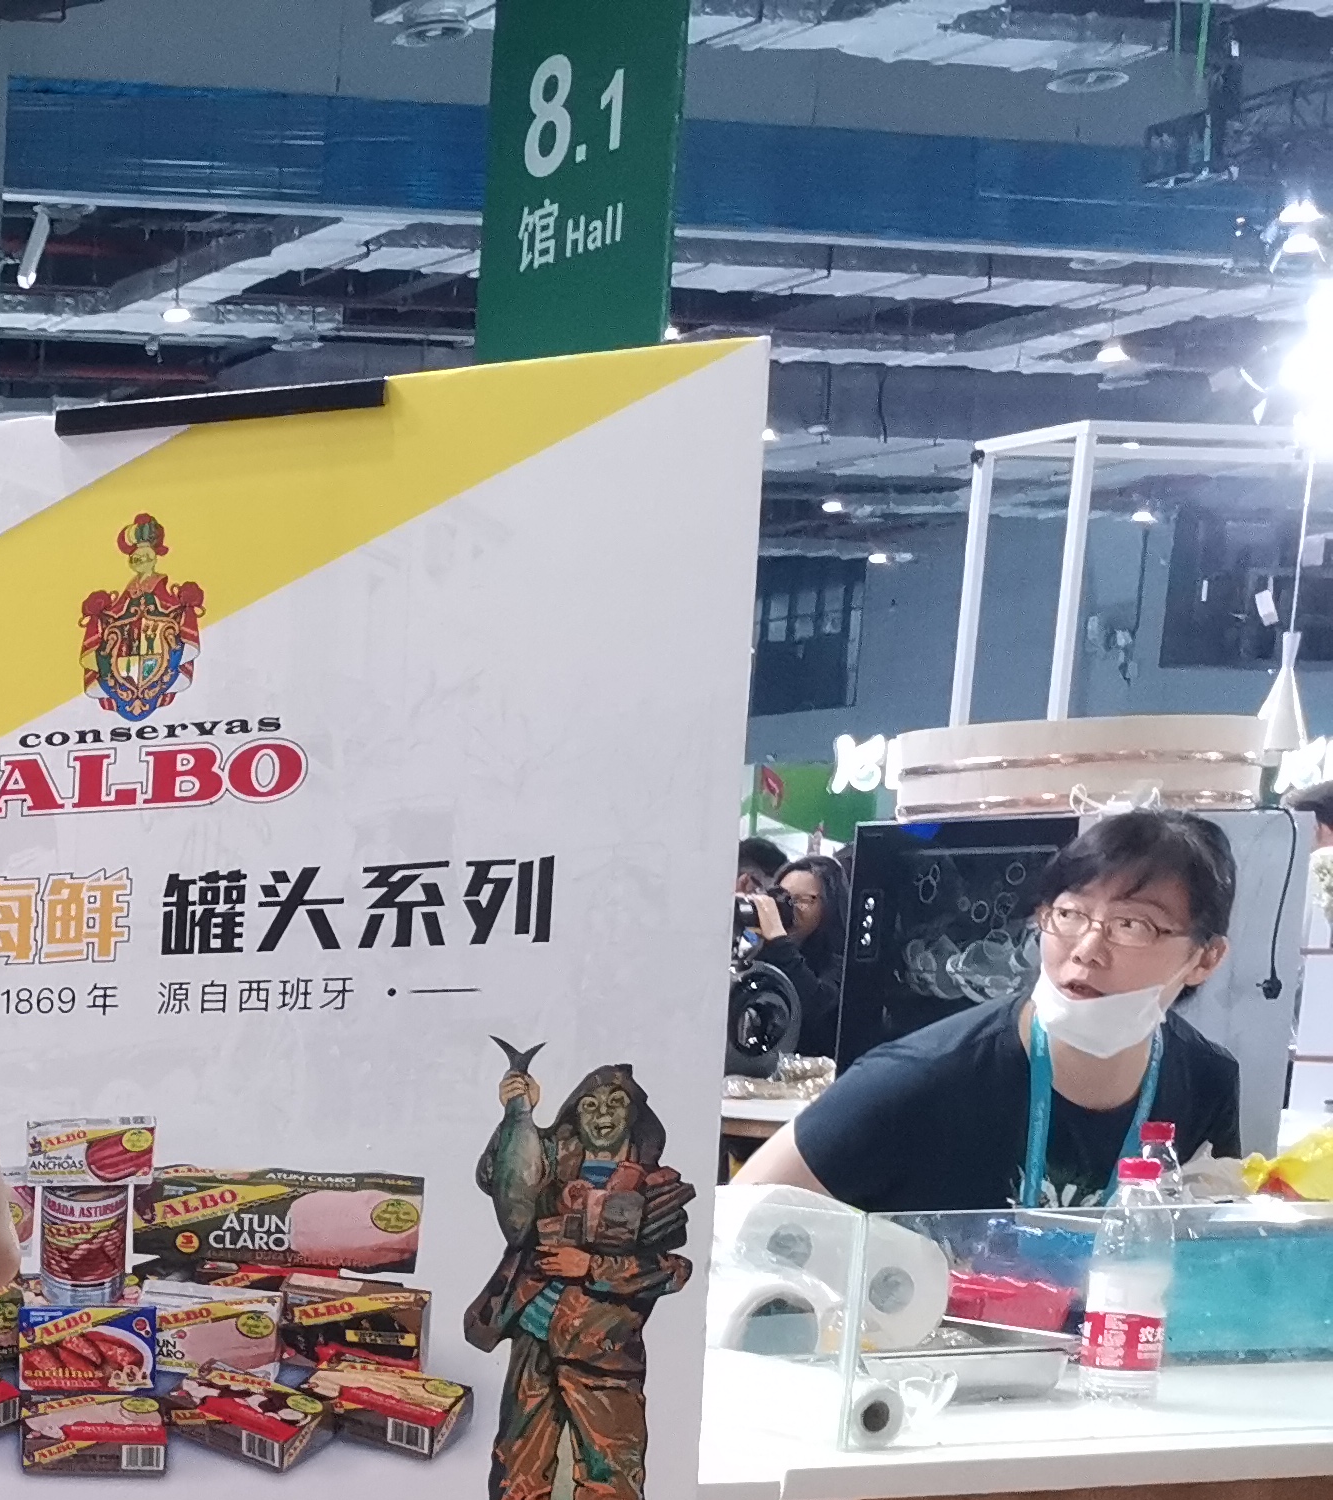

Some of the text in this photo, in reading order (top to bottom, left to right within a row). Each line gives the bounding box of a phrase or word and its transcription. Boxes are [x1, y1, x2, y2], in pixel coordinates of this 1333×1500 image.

[524, 54, 625, 178] 8.1
[518, 198, 624, 273] 馆 Hall
[18, 716, 282, 749] conservas
[160, 855, 555, 956] 罐头系列
[157, 977, 354, 1015] 源自西班牙
[29, 1160, 84, 1170] ANCHOAS
[162, 1188, 238, 1220] ALBO
[222, 1212, 292, 1234] ATUN
[208, 1232, 292, 1251] CLARO
[42, 1310, 93, 1338] ALBO
[296, 1303, 354, 1323] ALBO
